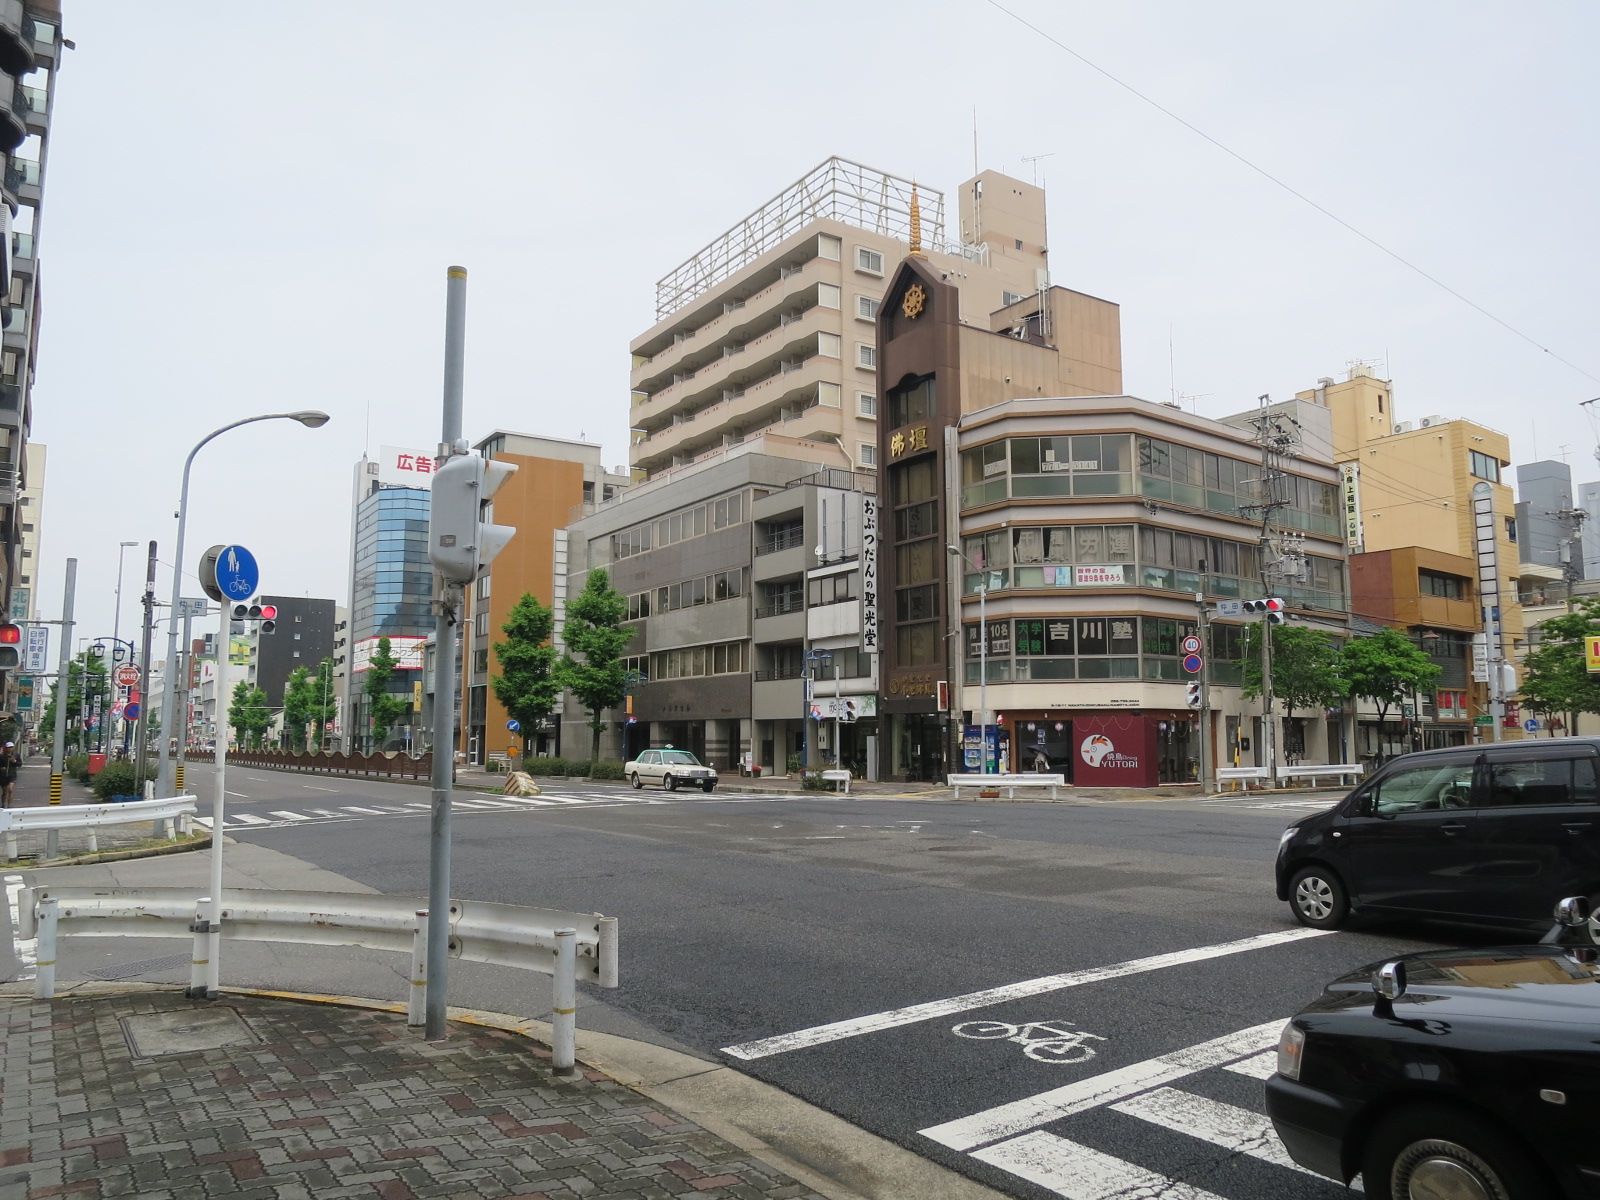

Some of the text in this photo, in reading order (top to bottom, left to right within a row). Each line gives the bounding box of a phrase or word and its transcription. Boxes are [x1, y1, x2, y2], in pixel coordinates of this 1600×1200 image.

[864, 499, 877, 647] おぶつだんの聖光堂
[1048, 622, 1133, 641] 吉川塾
[1187, 641, 1197, 649] 40
